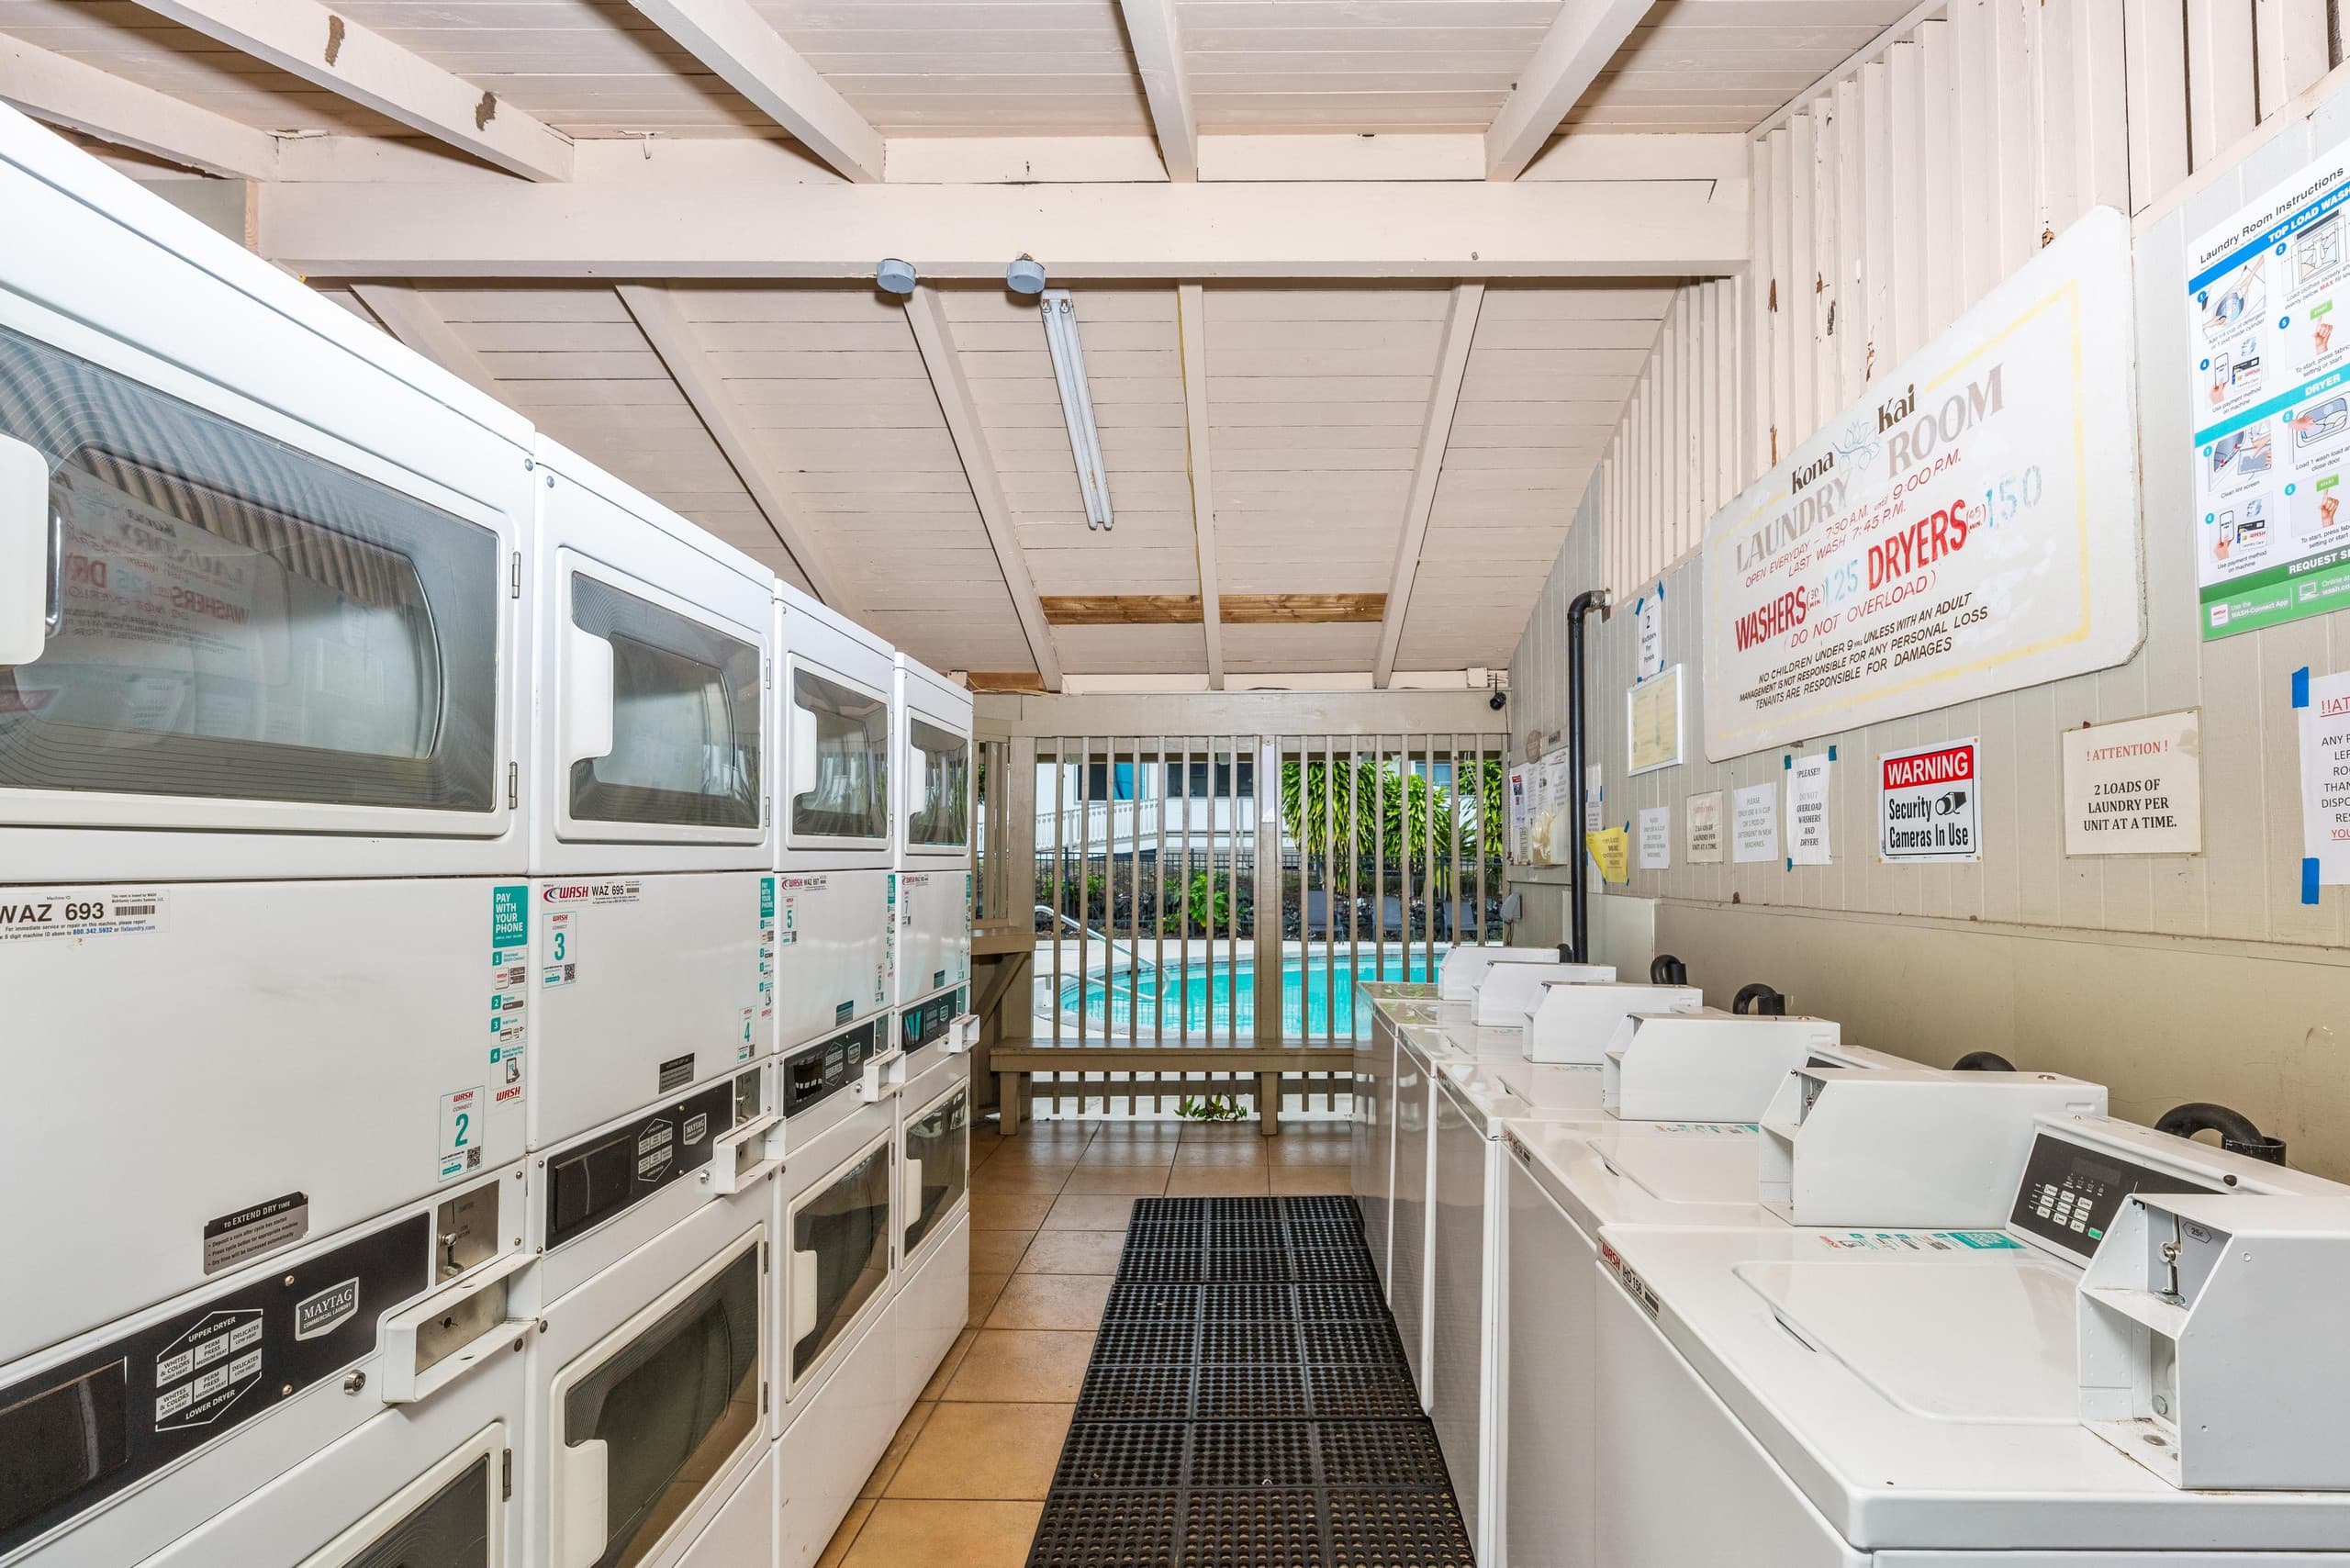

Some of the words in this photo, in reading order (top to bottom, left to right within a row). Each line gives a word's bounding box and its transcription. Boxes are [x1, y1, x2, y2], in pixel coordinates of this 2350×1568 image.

[2200, 234, 2239, 264] Laundry
[2243, 212, 2272, 238] Room
[2276, 168, 2344, 216] Instructions
[2268, 224, 2289, 243] TOP
[2290, 207, 2319, 230] LOAD
[2320, 280, 2333, 291] MAX
[2304, 374, 2341, 396] DRYER
[1877, 383, 1915, 434] Kai
[2296, 459, 2310, 470] Load
[2315, 453, 2331, 463] wash
[2331, 447, 2344, 458] load
[2311, 462, 2324, 472] close
[2325, 457, 2341, 468] door
[1736, 469, 1851, 576] LAUNDRY
[1887, 362, 2005, 480] ROOM
[1792, 451, 1834, 496] Kona
[2221, 488, 2234, 498] Clean
[2244, 480, 2260, 490] screen
[1745, 567, 1766, 588] OPEN
[1769, 542, 1810, 574] EVERYDAY
[1893, 466, 1930, 500] 9:00
[1933, 448, 1962, 476] P.M.
[1788, 554, 1812, 577] LAST
[1816, 536, 1846, 562] WASH
[1852, 515, 1879, 540] 7:45
[1881, 500, 1906, 523] P.M.
[2309, 538, 2327, 549] setting
[2335, 532, 2349, 542] start
[2323, 528, 2339, 538] press
[2217, 562, 2227, 570] Use
[2227, 555, 2247, 568] payment
[2247, 550, 2267, 561] method
[2235, 560, 2255, 572] machine
[2288, 553, 2338, 574] REQUEST
[1735, 585, 1807, 653] WASHERS
[1867, 499, 1967, 591] DRYERS
[2276, 599, 2288, 610] App
[1813, 613, 1841, 639] NOT
[1759, 671, 1770, 684] NO
[1771, 654, 1813, 679] CHILDREN
[1815, 643, 1846, 663] UNDER
[1847, 639, 1853, 651] 9
[1863, 622, 1895, 644] UNLESS
[1897, 614, 1917, 632] WITH
[1919, 608, 1933, 624] AN
[1935, 592, 1973, 617] ADULT
[1739, 682, 1777, 702] MANAGEMENT
[1777, 679, 1783, 689] IS
[1783, 675, 1796, 687] NOT
[1796, 656, 1847, 683] RESPONSIBLE
[1849, 649, 1866, 666] FOR
[1867, 642, 1888, 658] ANY
[1890, 622, 1948, 651] PERSONAL
[1953, 606, 1988, 629] LOSS
[1755, 692, 1788, 710] TENANTS
[1785, 686, 1801, 700] ARE
[1803, 666, 1861, 694] RESPONSIBLE
[1866, 657, 1888, 676] FOR
[1894, 636, 1953, 667] DAMAGES
[2322, 734, 2344, 746] ANY
[2092, 741, 2161, 761] ATTENTION
[1887, 751, 1968, 786] WARNING
[2094, 785, 2100, 796] 2
[2103, 780, 2142, 795] LOADS
[2144, 778, 2161, 791] OF
[1796, 802, 1822, 812] OVERLOAD
[1889, 795, 1931, 823] Security
[2088, 799, 2142, 813] LAUNDRY
[2144, 797, 2169, 810] PER
[1798, 814, 1821, 823] WASHERS
[2084, 819, 2109, 831] UNIT
[2112, 818, 2128, 830] AT
[2131, 817, 2140, 829] A
[2142, 815, 2177, 829] TIME.
[1804, 826, 1815, 834] AND
[1889, 826, 1932, 848] Cameras
[1935, 823, 1945, 846] In
[1948, 823, 1969, 846] Use
[1800, 837, 1819, 846] DRYERS
[496, 892, 511, 903] PAY
[559, 886, 589, 899] WASH
[591, 886, 610, 897] WAZ
[611, 885, 624, 895] 695
[0, 903, 52, 924] WAZ
[65, 902, 105, 921] 693
[496, 902, 517, 913] WITH
[496, 913, 518, 924] YOUR
[787, 910, 793, 929] 5
[496, 922, 523, 934] PHONE
[554, 932, 565, 961] 3
[744, 1022, 750, 1043] 4
[453, 1091, 474, 1103] WASH
[496, 1086, 521, 1102] WASH
[454, 1113, 469, 1148] 2
[232, 1209, 262, 1226] EXTEND
[263, 1204, 277, 1215] DRY
[278, 1200, 291, 1210] TIME
[1602, 1241, 1621, 1271] WASH
[304, 1288, 352, 1321] MAYTAG
[188, 1327, 212, 1343] UPPER
[213, 1316, 236, 1332] DRYER
[232, 1325, 260, 1340] DELICATES
[246, 1331, 257, 1340] HEAT
[204, 1339, 220, 1350] PERM
[204, 1345, 221, 1357] PRESS
[163, 1354, 187, 1369] WHITES
[167, 1359, 190, 1373] COLORS
[196, 1354, 216, 1366] MEDIUM
[216, 1348, 228, 1358] HEAT
[231, 1355, 259, 1372] DELICATES
[245, 1362, 256, 1372] HEAT
[203, 1371, 220, 1383] PERM
[203, 1377, 220, 1389] PRESS
[162, 1387, 186, 1403] WHITES
[196, 1386, 215, 1399] MEDIUM
[215, 1380, 227, 1389] HEAT
[166, 1393, 190, 1407] COLORS
[185, 1404, 212, 1420] LOWER
[212, 1389, 236, 1406] DRYER
